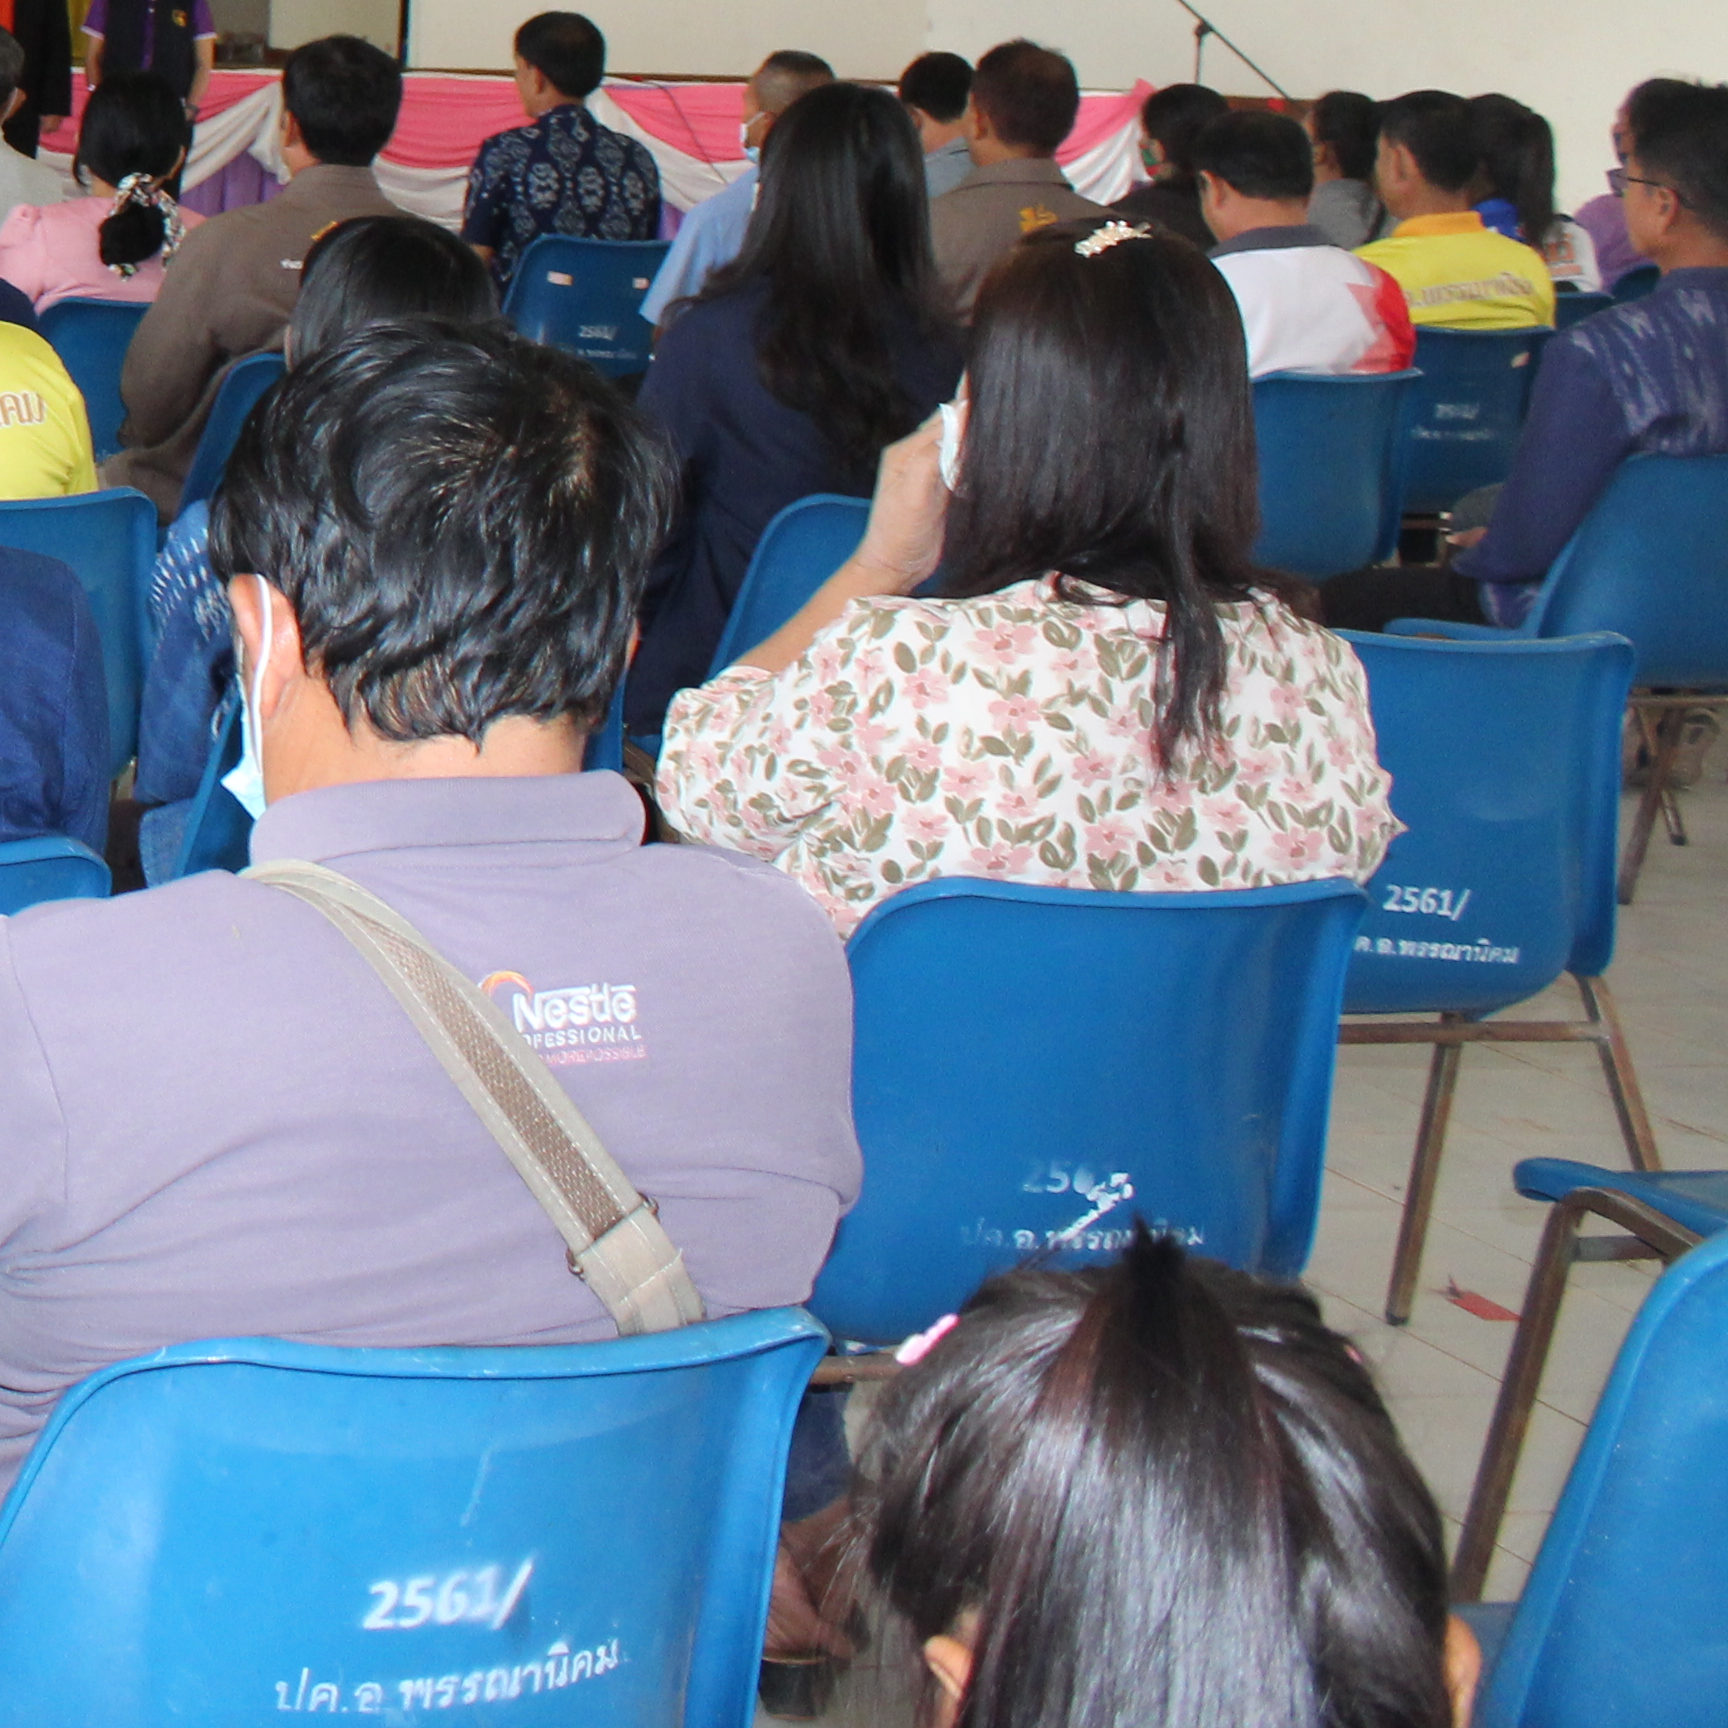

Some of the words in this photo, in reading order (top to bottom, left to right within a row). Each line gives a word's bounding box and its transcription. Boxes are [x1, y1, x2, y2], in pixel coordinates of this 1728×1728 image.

[1382, 883, 1472, 922] 2561/
[522, 1024, 643, 1050] FESSIONAL
[361, 1554, 535, 1630] 2561/
